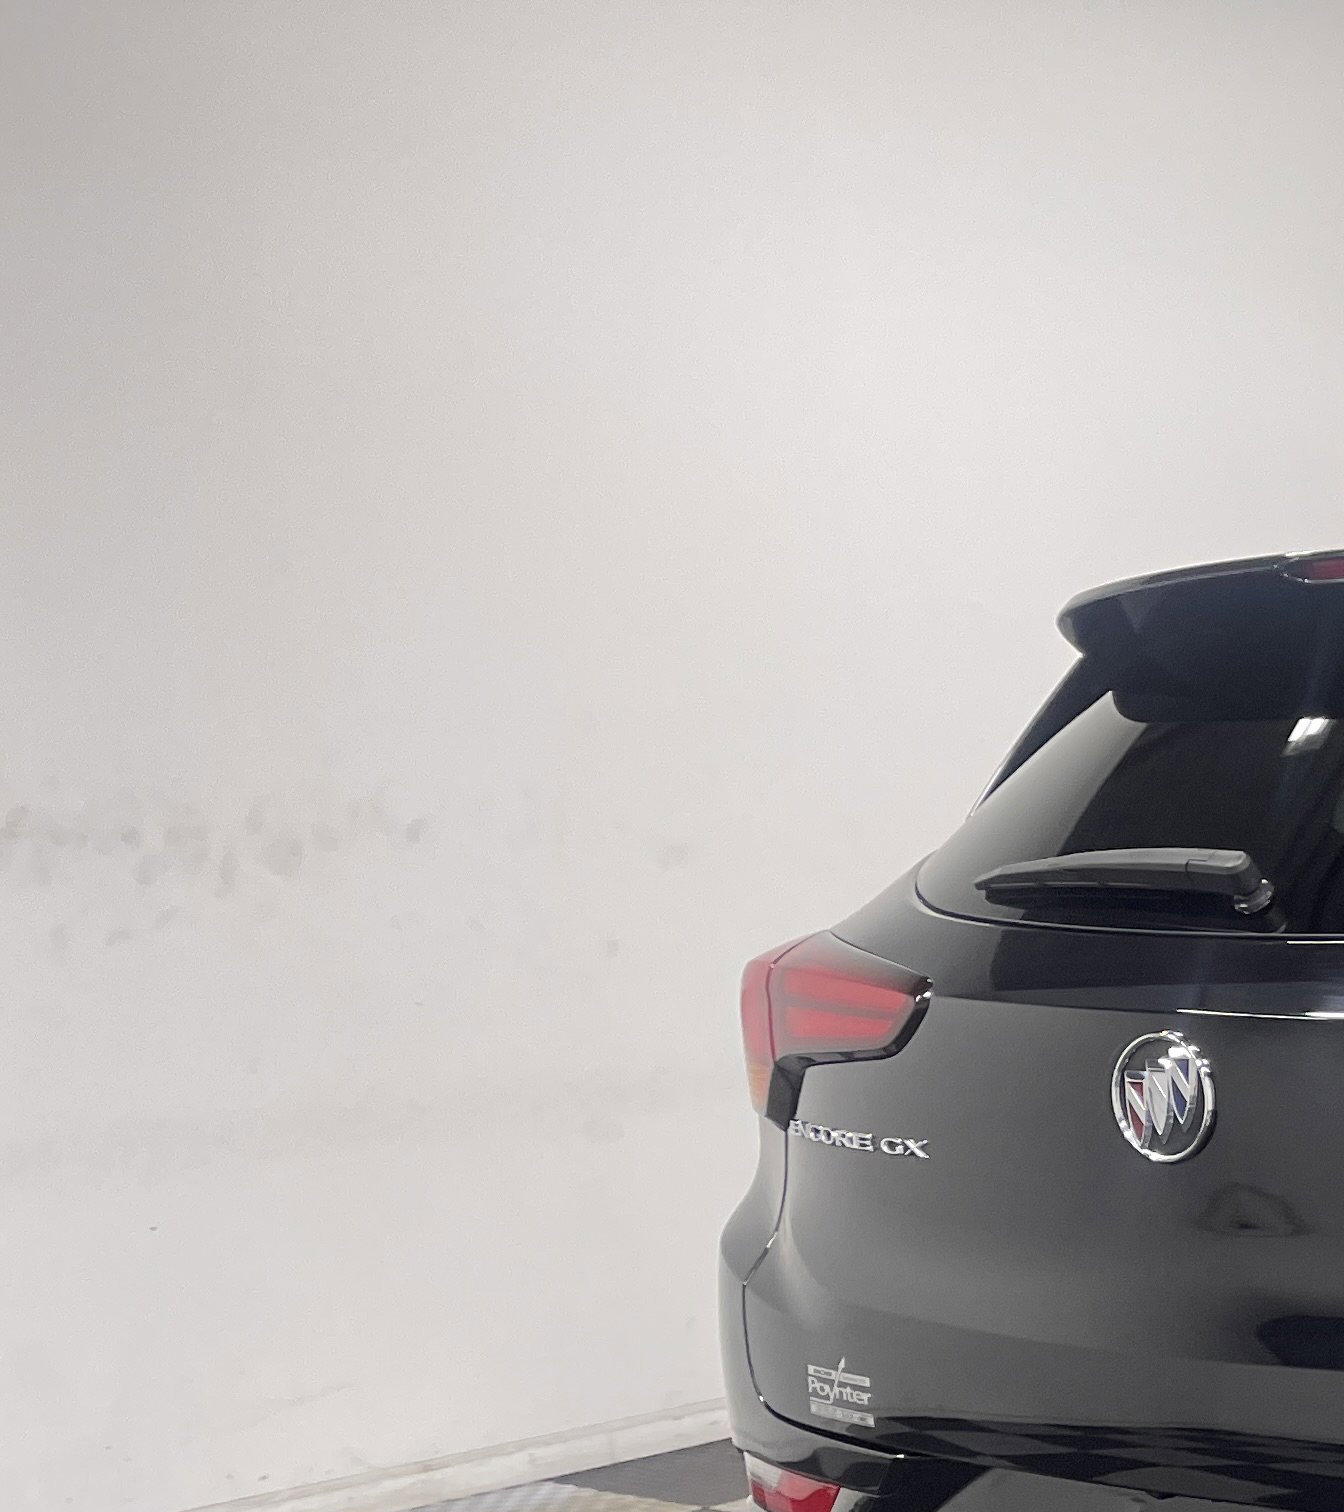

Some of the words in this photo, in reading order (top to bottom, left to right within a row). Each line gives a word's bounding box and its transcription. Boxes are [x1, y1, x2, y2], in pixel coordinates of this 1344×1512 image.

[788, 1119, 874, 1152] ENCORE
[880, 1137, 931, 1159] GX
[807, 1375, 872, 1405] Poynter
